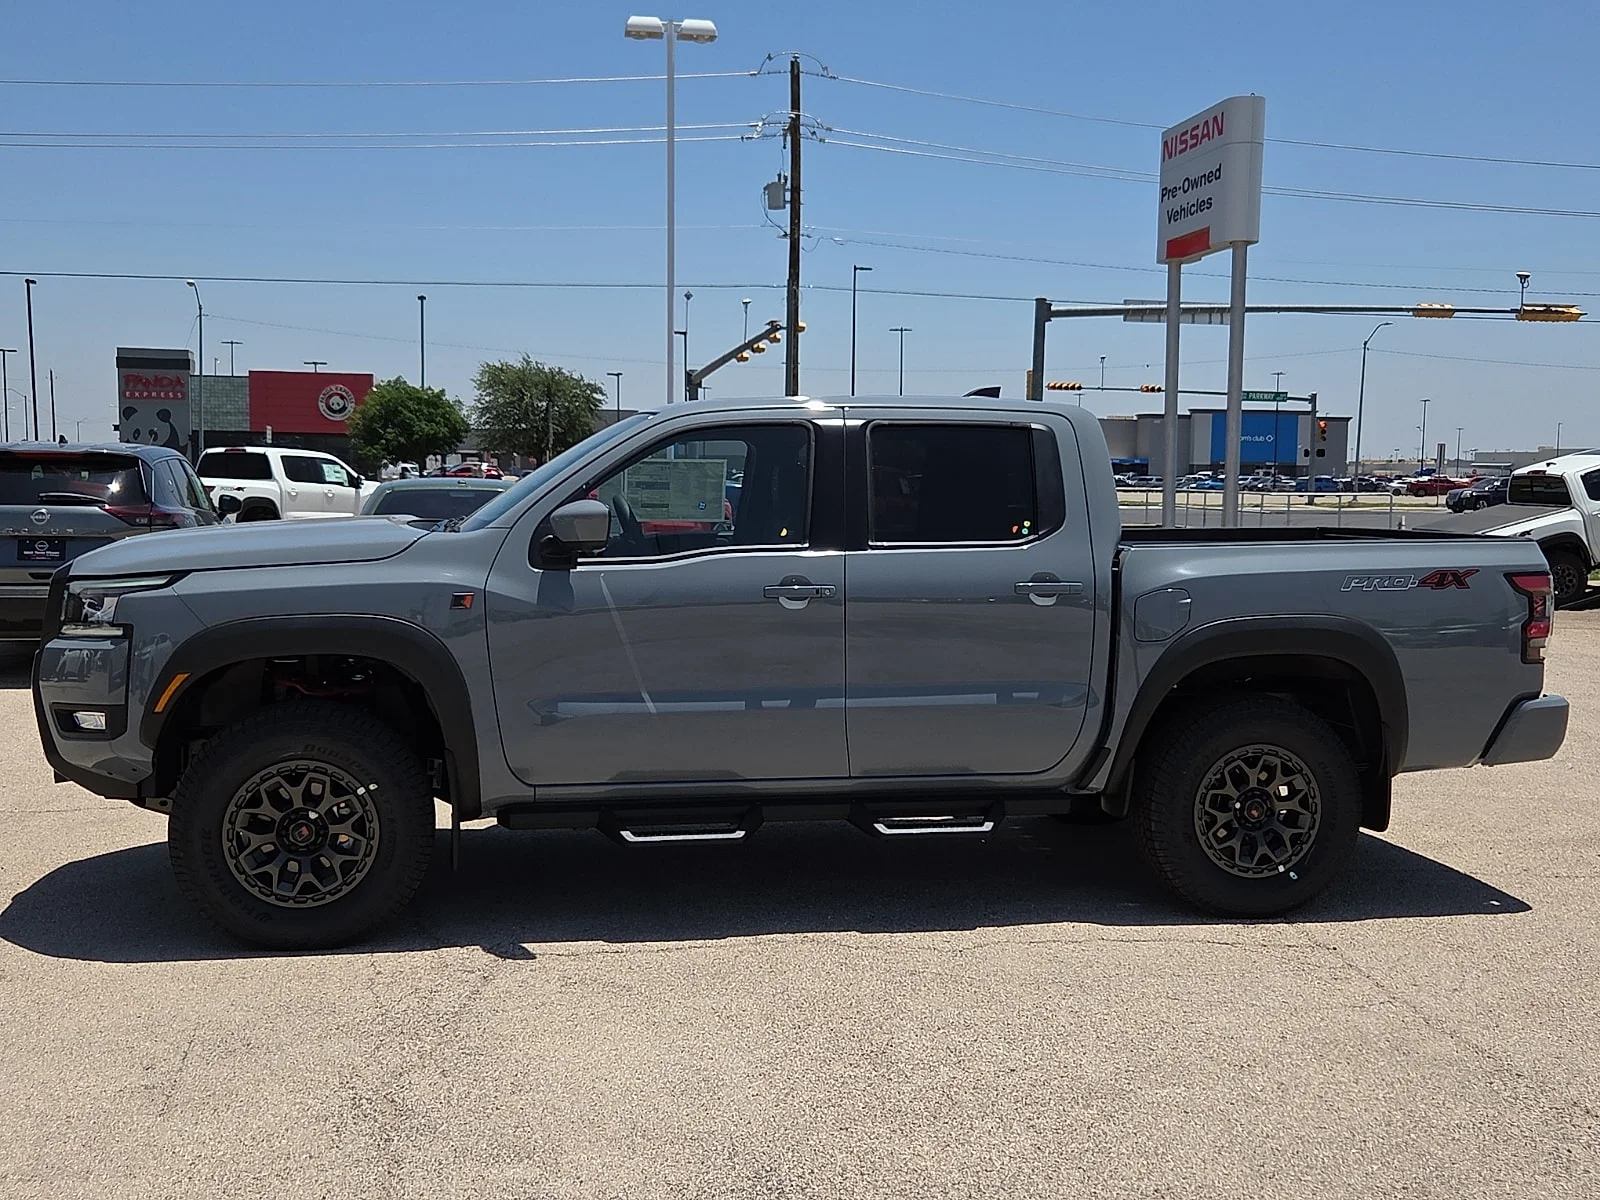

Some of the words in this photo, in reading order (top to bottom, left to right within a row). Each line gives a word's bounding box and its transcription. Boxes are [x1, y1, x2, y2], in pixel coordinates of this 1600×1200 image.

[1162, 112, 1225, 162] NISSAN
[1161, 163, 1222, 203] Pre-Owned
[1166, 197, 1213, 224] Vehicles
[123, 373, 185, 390] PANDA
[1248, 392, 1275, 401] PARKWAY
[1340, 568, 1480, 591] PRO-4X
